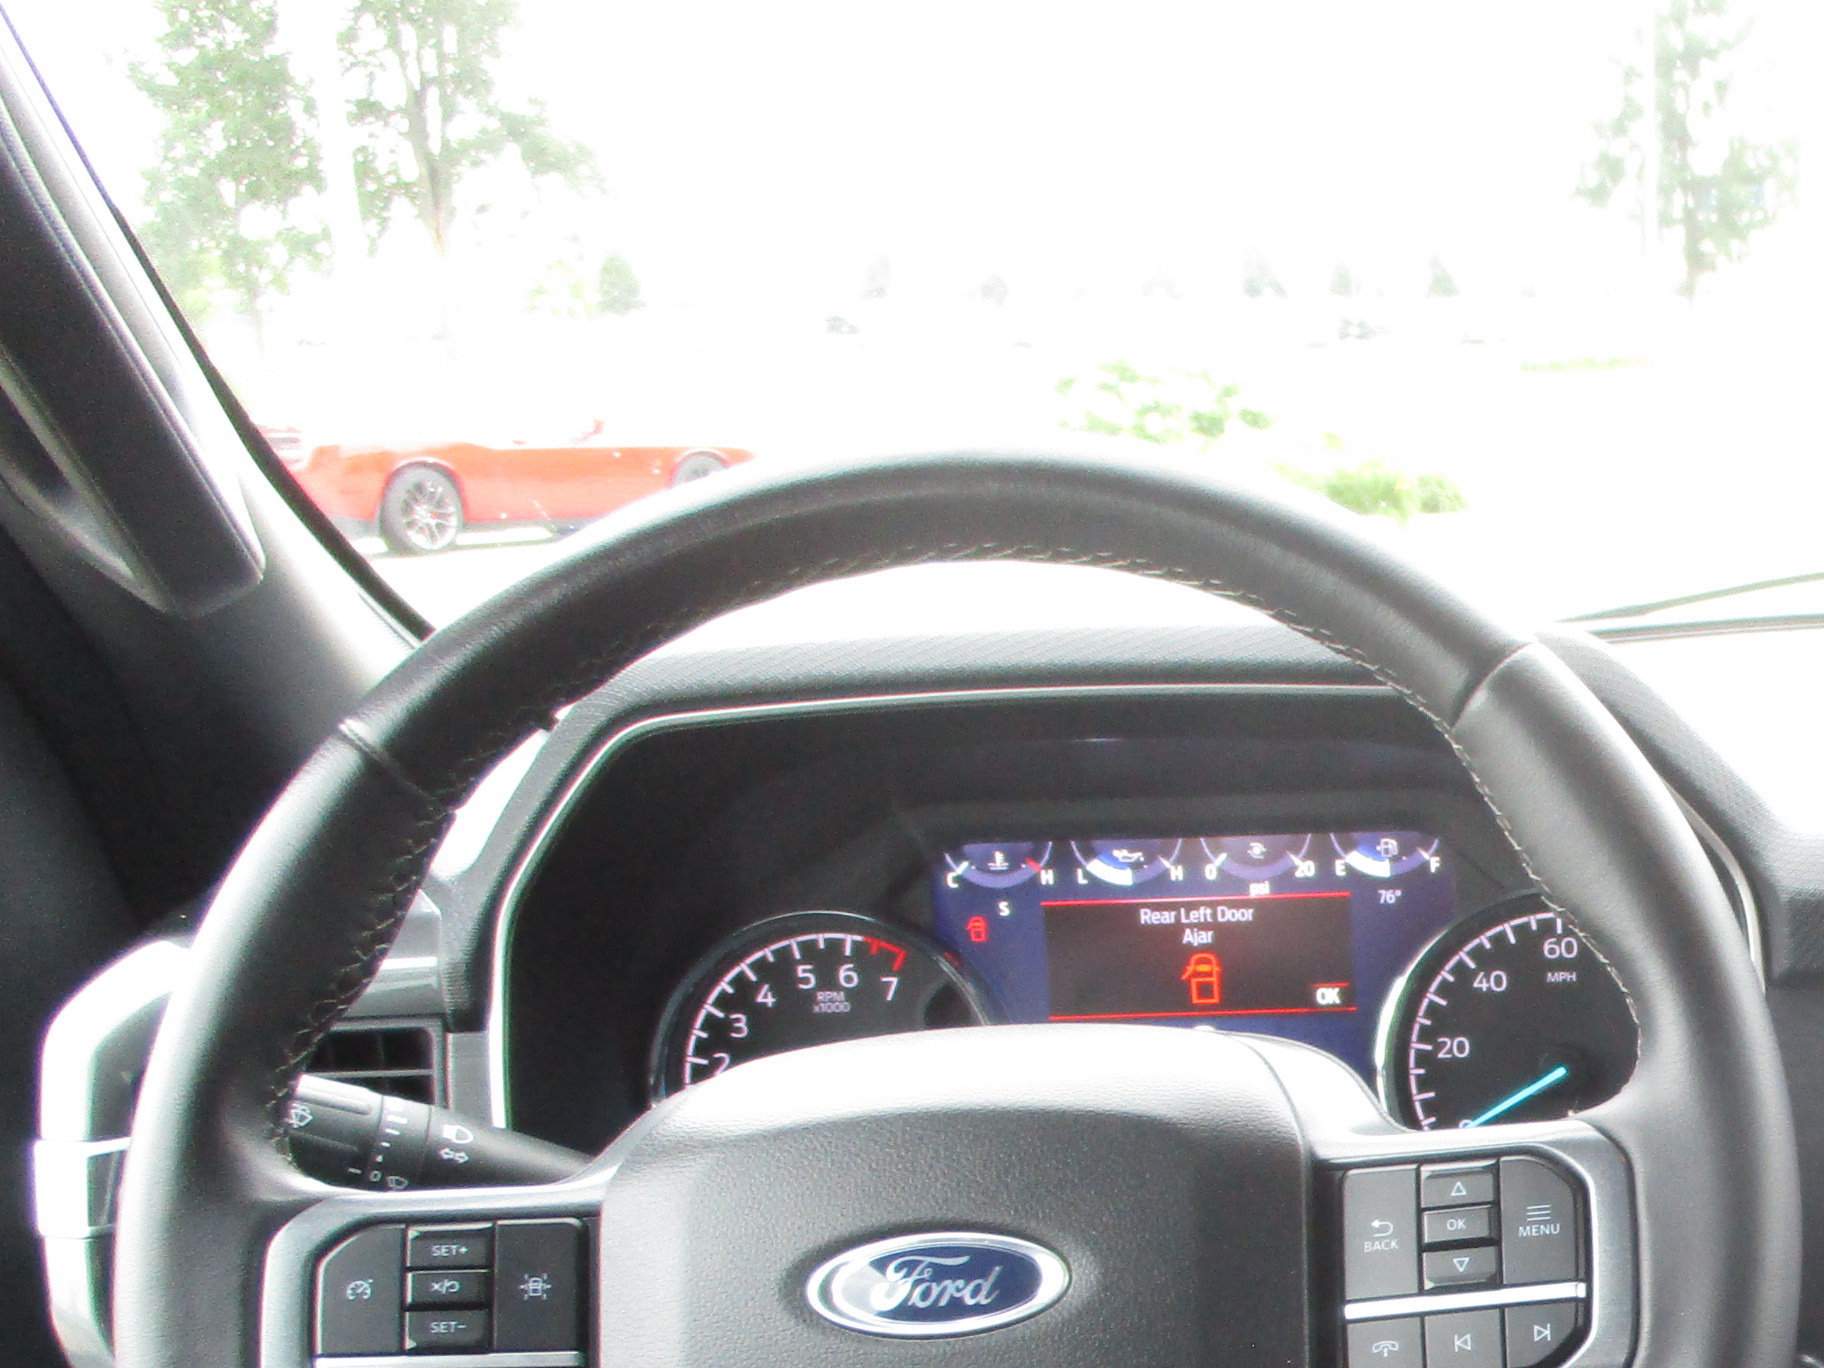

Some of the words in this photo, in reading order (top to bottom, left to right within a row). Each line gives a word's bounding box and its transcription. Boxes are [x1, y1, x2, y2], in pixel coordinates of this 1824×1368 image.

[1170, 865, 1184, 881] H
[1294, 860, 1316, 878] 20
[1335, 860, 1346, 876] E
[1429, 857, 1441, 873] F
[946, 871, 959, 888] C
[1040, 869, 1054, 885] H
[1077, 869, 1088, 885] L
[1249, 881, 1271, 897] psi
[998, 901, 1010, 917] S
[1140, 907, 1176, 925] Rear
[1180, 906, 1213, 923] Left
[1217, 905, 1255, 922] Door
[1182, 929, 1214, 947] Ajar
[1542, 936, 1579, 959] 60
[798, 964, 817, 990] 5
[838, 963, 859, 989] 6
[1471, 970, 1508, 993] 40
[1546, 971, 1577, 984] MPH
[756, 983, 777, 1008] 4
[816, 991, 846, 1002] RPM
[881, 976, 900, 1001] 7
[1315, 988, 1341, 1006] OK
[812, 1002, 851, 1013] x1000
[729, 1013, 749, 1039] 3
[1437, 1036, 1470, 1059] 20
[712, 1053, 730, 1075] 2
[1446, 1218, 1468, 1231] OK
[1518, 1222, 1561, 1238] MENU
[1363, 1238, 1400, 1254] BACK
[869, 1255, 1004, 1312] Ford
